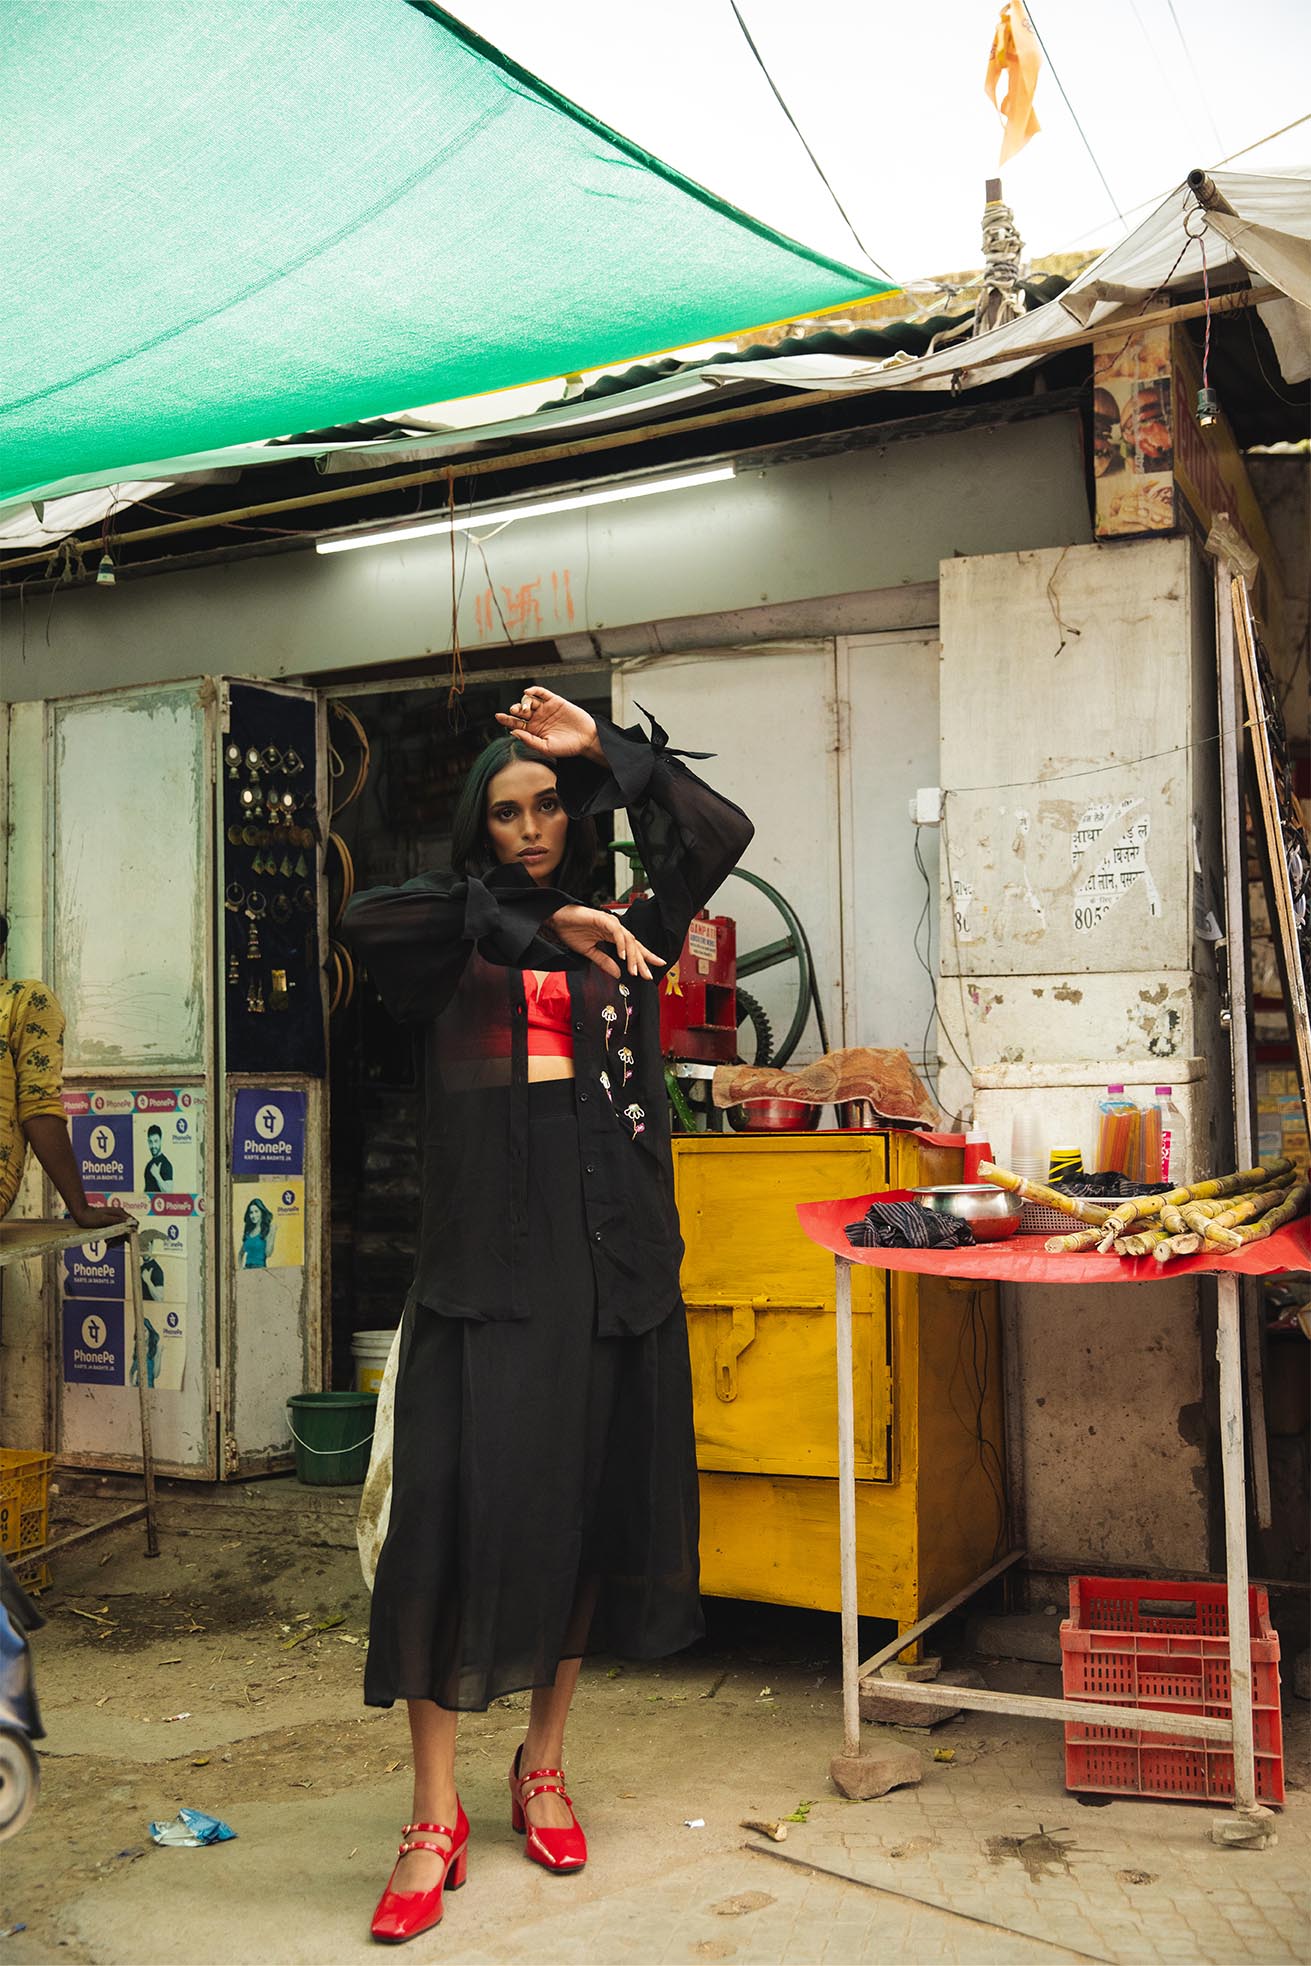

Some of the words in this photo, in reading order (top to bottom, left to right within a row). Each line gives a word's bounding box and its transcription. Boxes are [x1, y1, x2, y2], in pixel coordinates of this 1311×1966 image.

[106, 1099, 131, 1108] PhonePe
[149, 1098, 175, 1107] PhonePe
[244, 1140, 292, 1154] PhonePe
[82, 1160, 124, 1174] PhonePe
[73, 1263, 115, 1278] PhonePe
[74, 1349, 115, 1364] PhonePe
